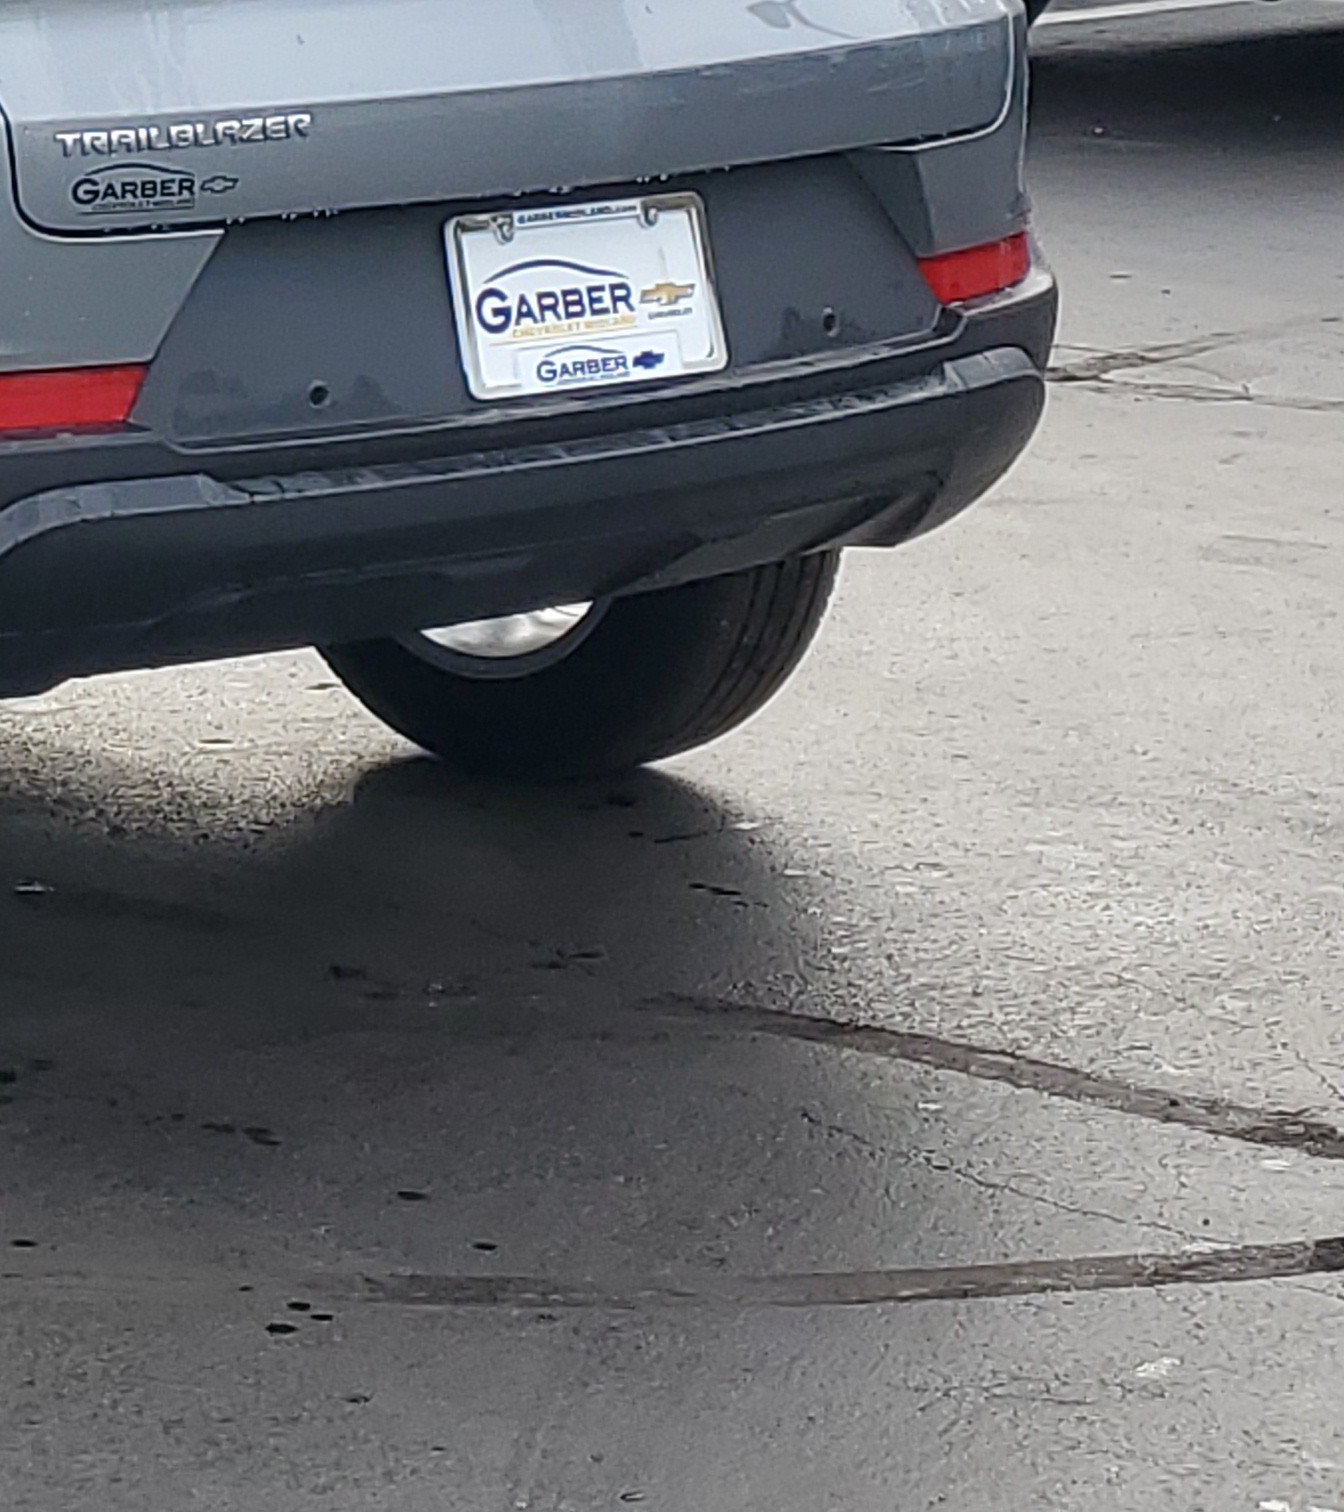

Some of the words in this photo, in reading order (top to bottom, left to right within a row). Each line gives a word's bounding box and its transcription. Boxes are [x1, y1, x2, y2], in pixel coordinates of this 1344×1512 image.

[55, 113, 311, 157] TRAILBLAZER
[71, 177, 195, 205] GARBER
[476, 282, 635, 334] GARBER
[537, 355, 628, 382] GARBER
